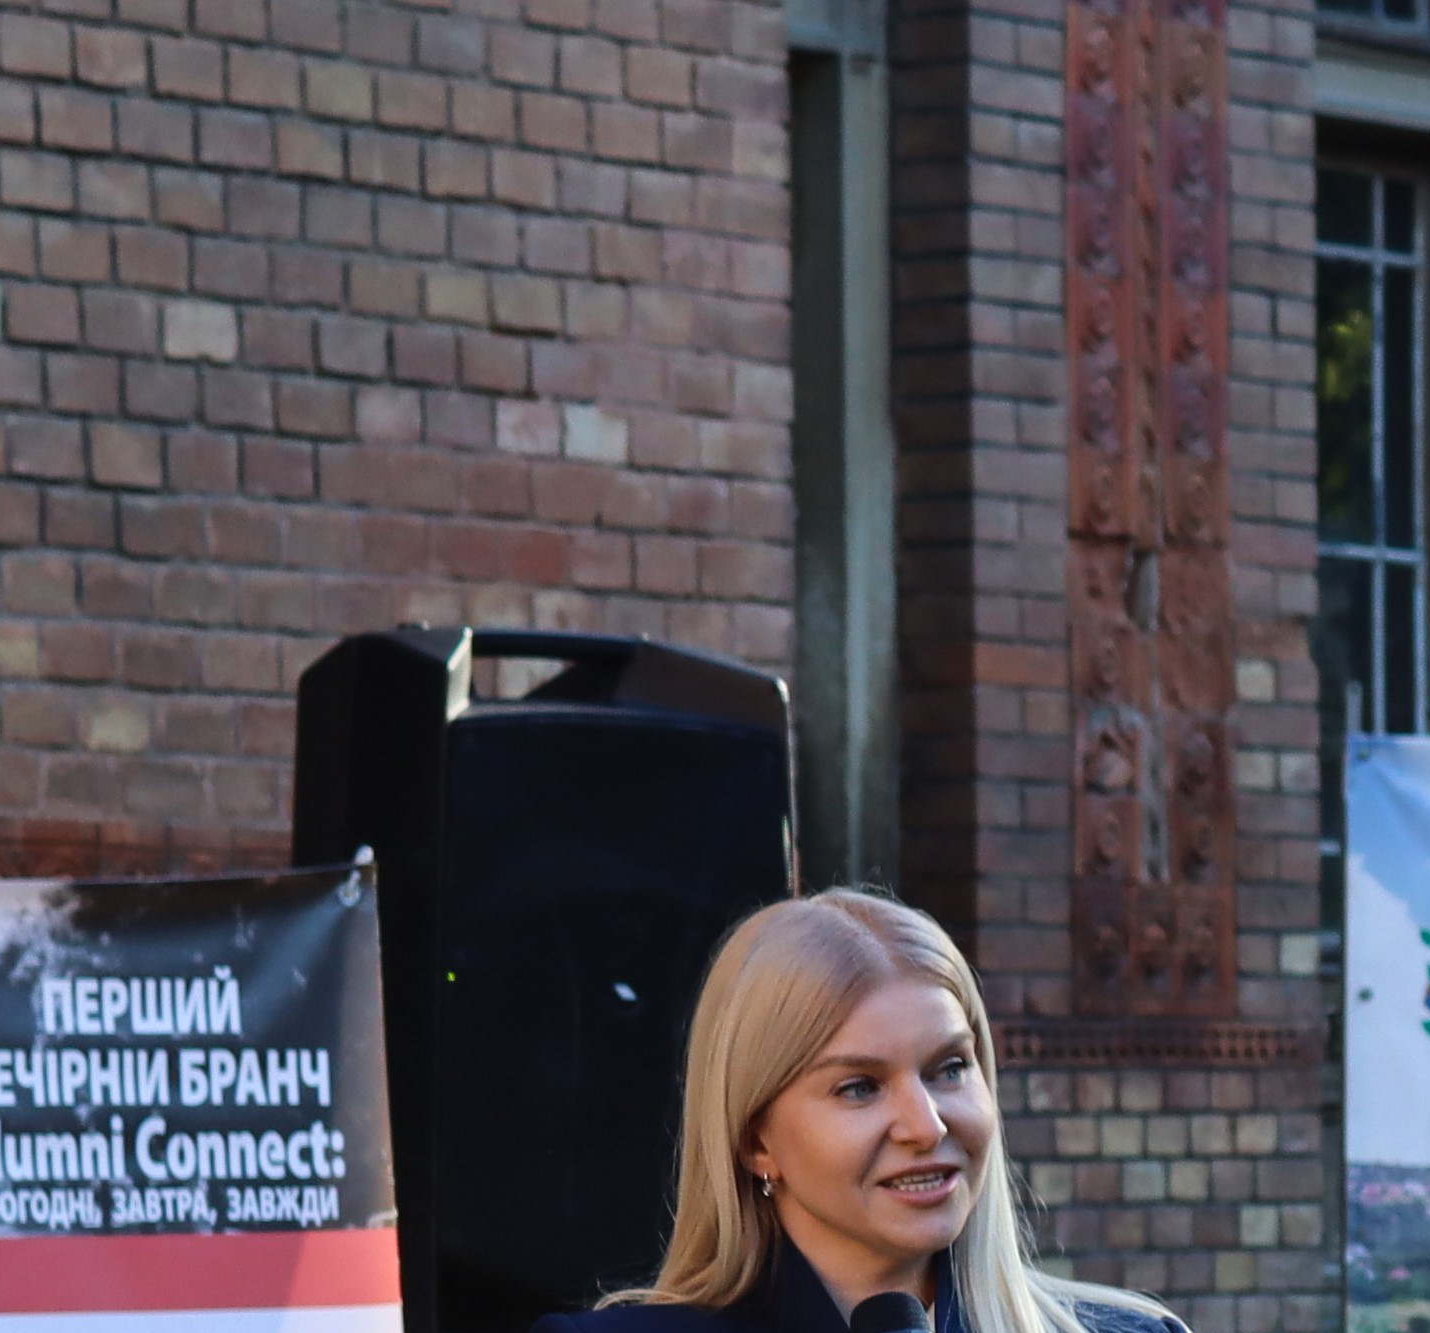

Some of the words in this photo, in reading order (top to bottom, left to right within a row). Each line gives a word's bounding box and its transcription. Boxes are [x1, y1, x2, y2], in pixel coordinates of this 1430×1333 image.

[43, 964, 242, 1035] ПЕРШИЙ
[178, 1047, 332, 1107] БРАНЧ
[134, 1114, 347, 1182] Connect:
[111, 1187, 218, 1226] ЗАВТРА,
[226, 1184, 340, 1228] ЗАВЖДИ
